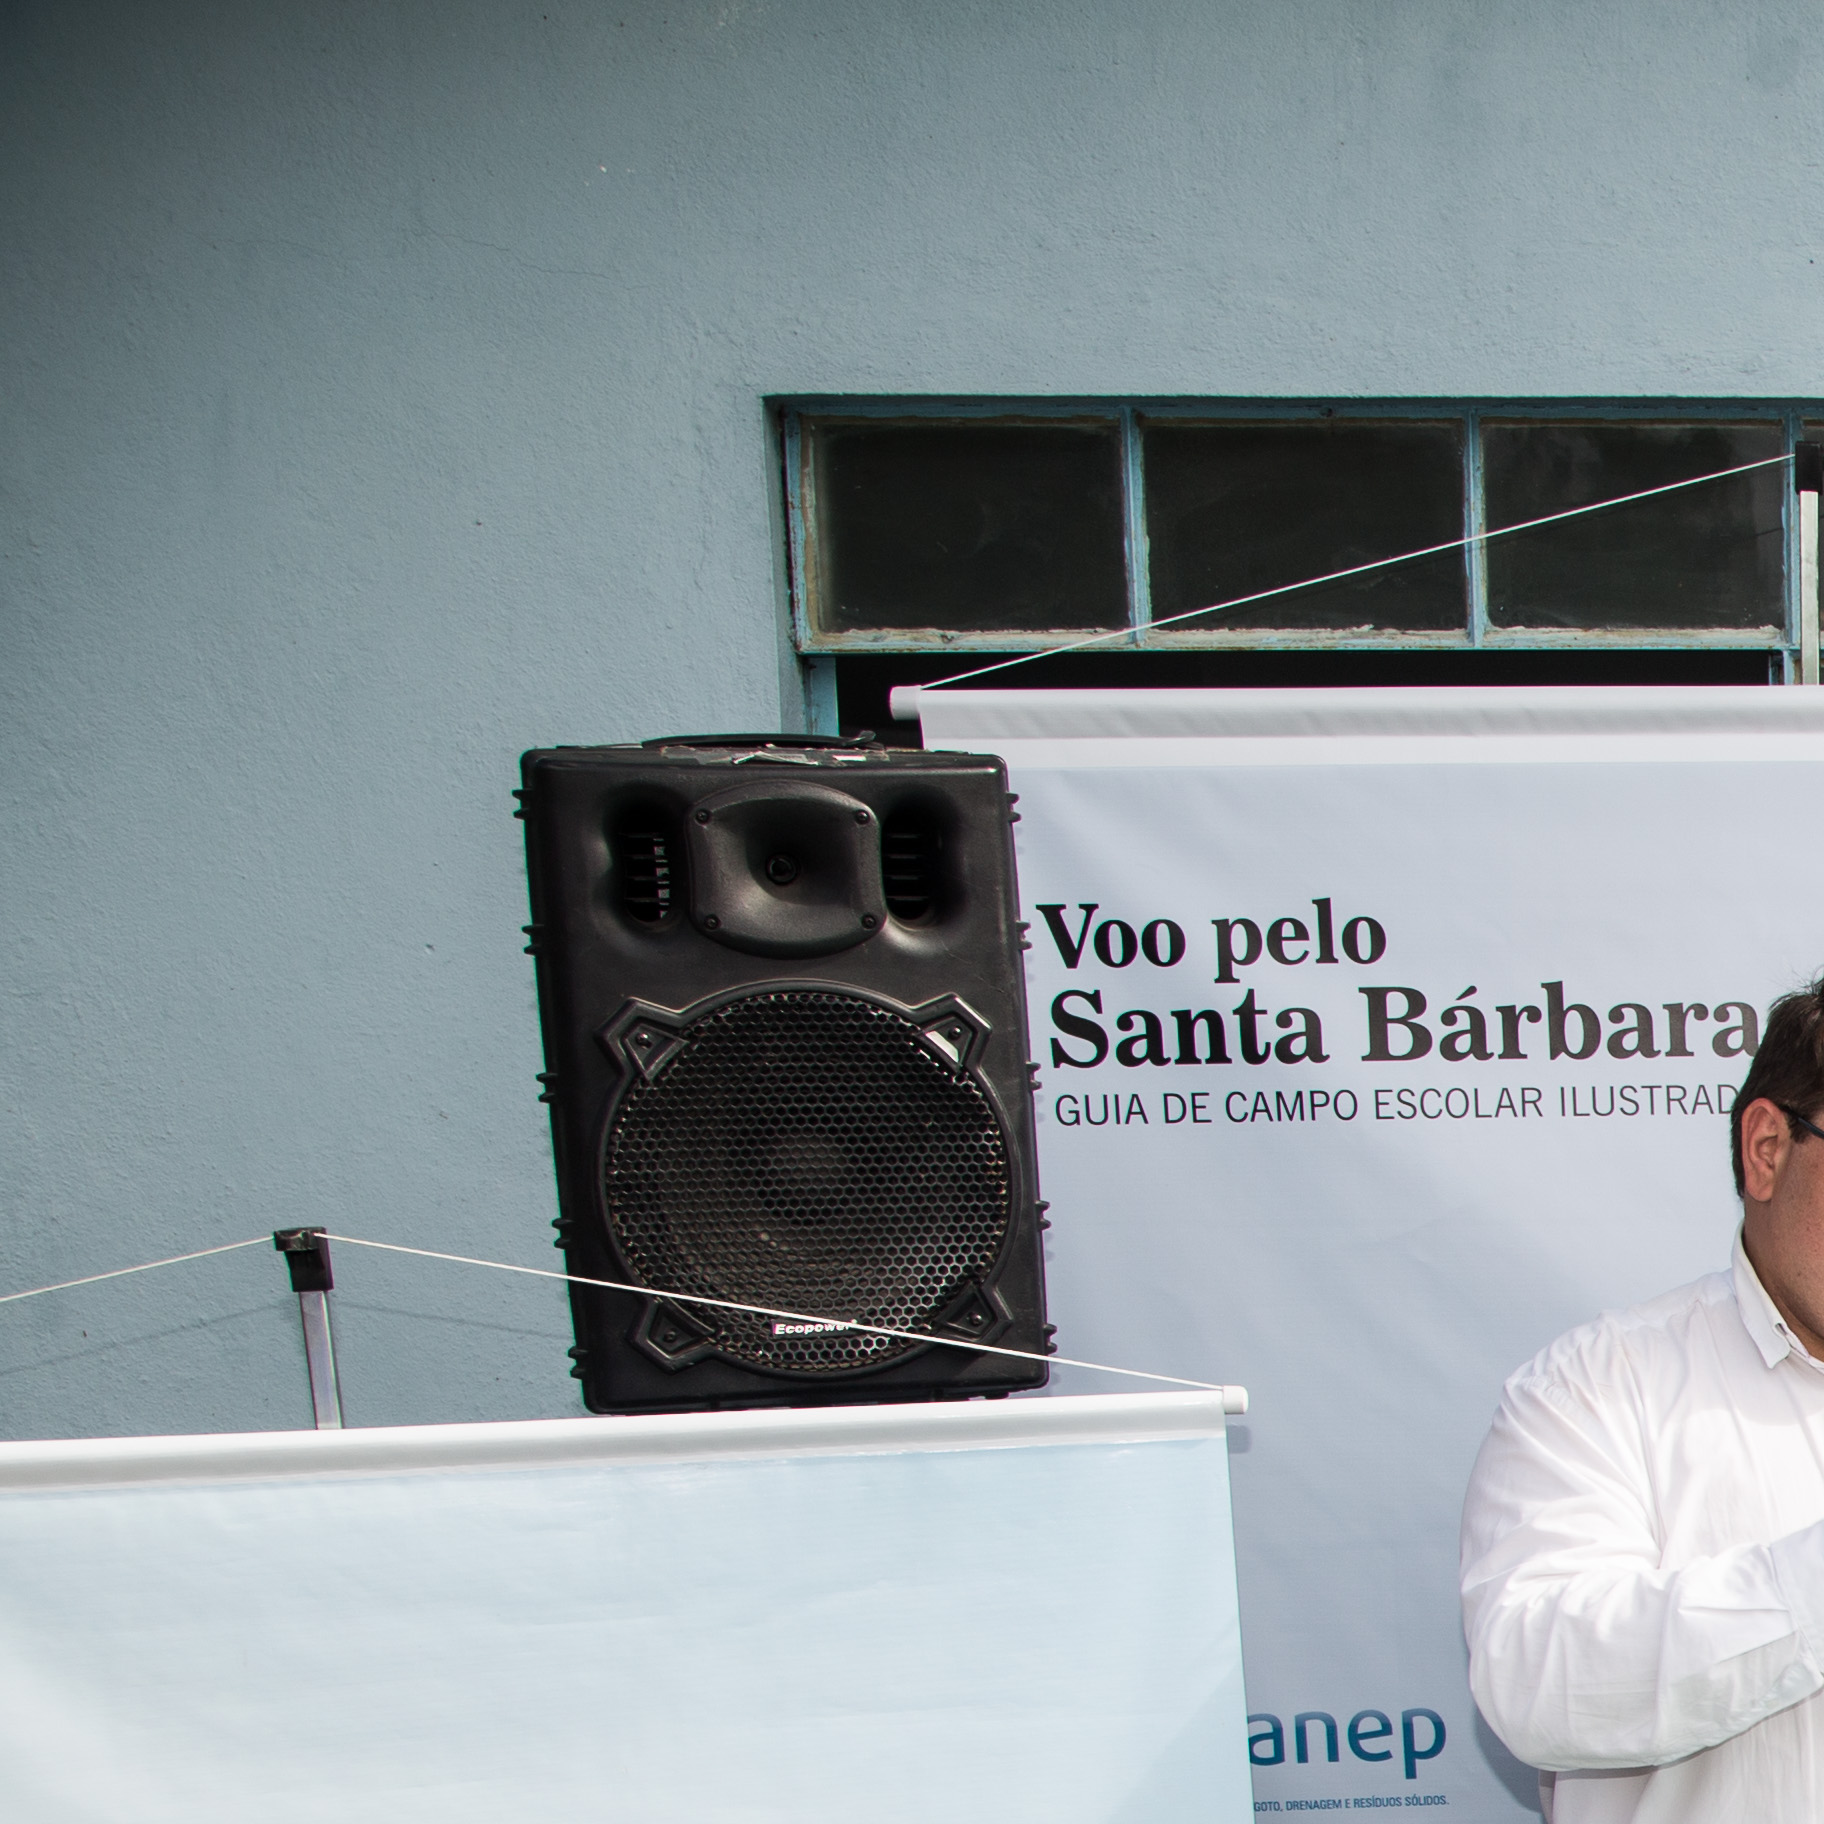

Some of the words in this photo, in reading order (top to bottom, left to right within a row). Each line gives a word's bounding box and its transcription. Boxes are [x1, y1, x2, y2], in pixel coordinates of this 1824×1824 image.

[1035, 903, 1186, 969] Voo
[1211, 897, 1387, 984] pelo
[1049, 988, 1331, 1069] Santa
[1358, 980, 1761, 1062] Bárbara
[1055, 1093, 1149, 1126] GUIA
[1162, 1092, 1213, 1124] DE
[1225, 1089, 1358, 1123] CAMPO
[1374, 1086, 1544, 1120] ESCOLAR
[1560, 1084, 1740, 1118] ILUSTRAD
[1246, 1707, 1447, 1780] anep
[1253, 1800, 1284, 1812] GOTO,
[1286, 1799, 1343, 1811] DRENAGEM
[1345, 1799, 1351, 1809] E
[1353, 1795, 1403, 1809] RESÍDUOS
[1405, 1794, 1450, 1807] SÓLIDOS.
